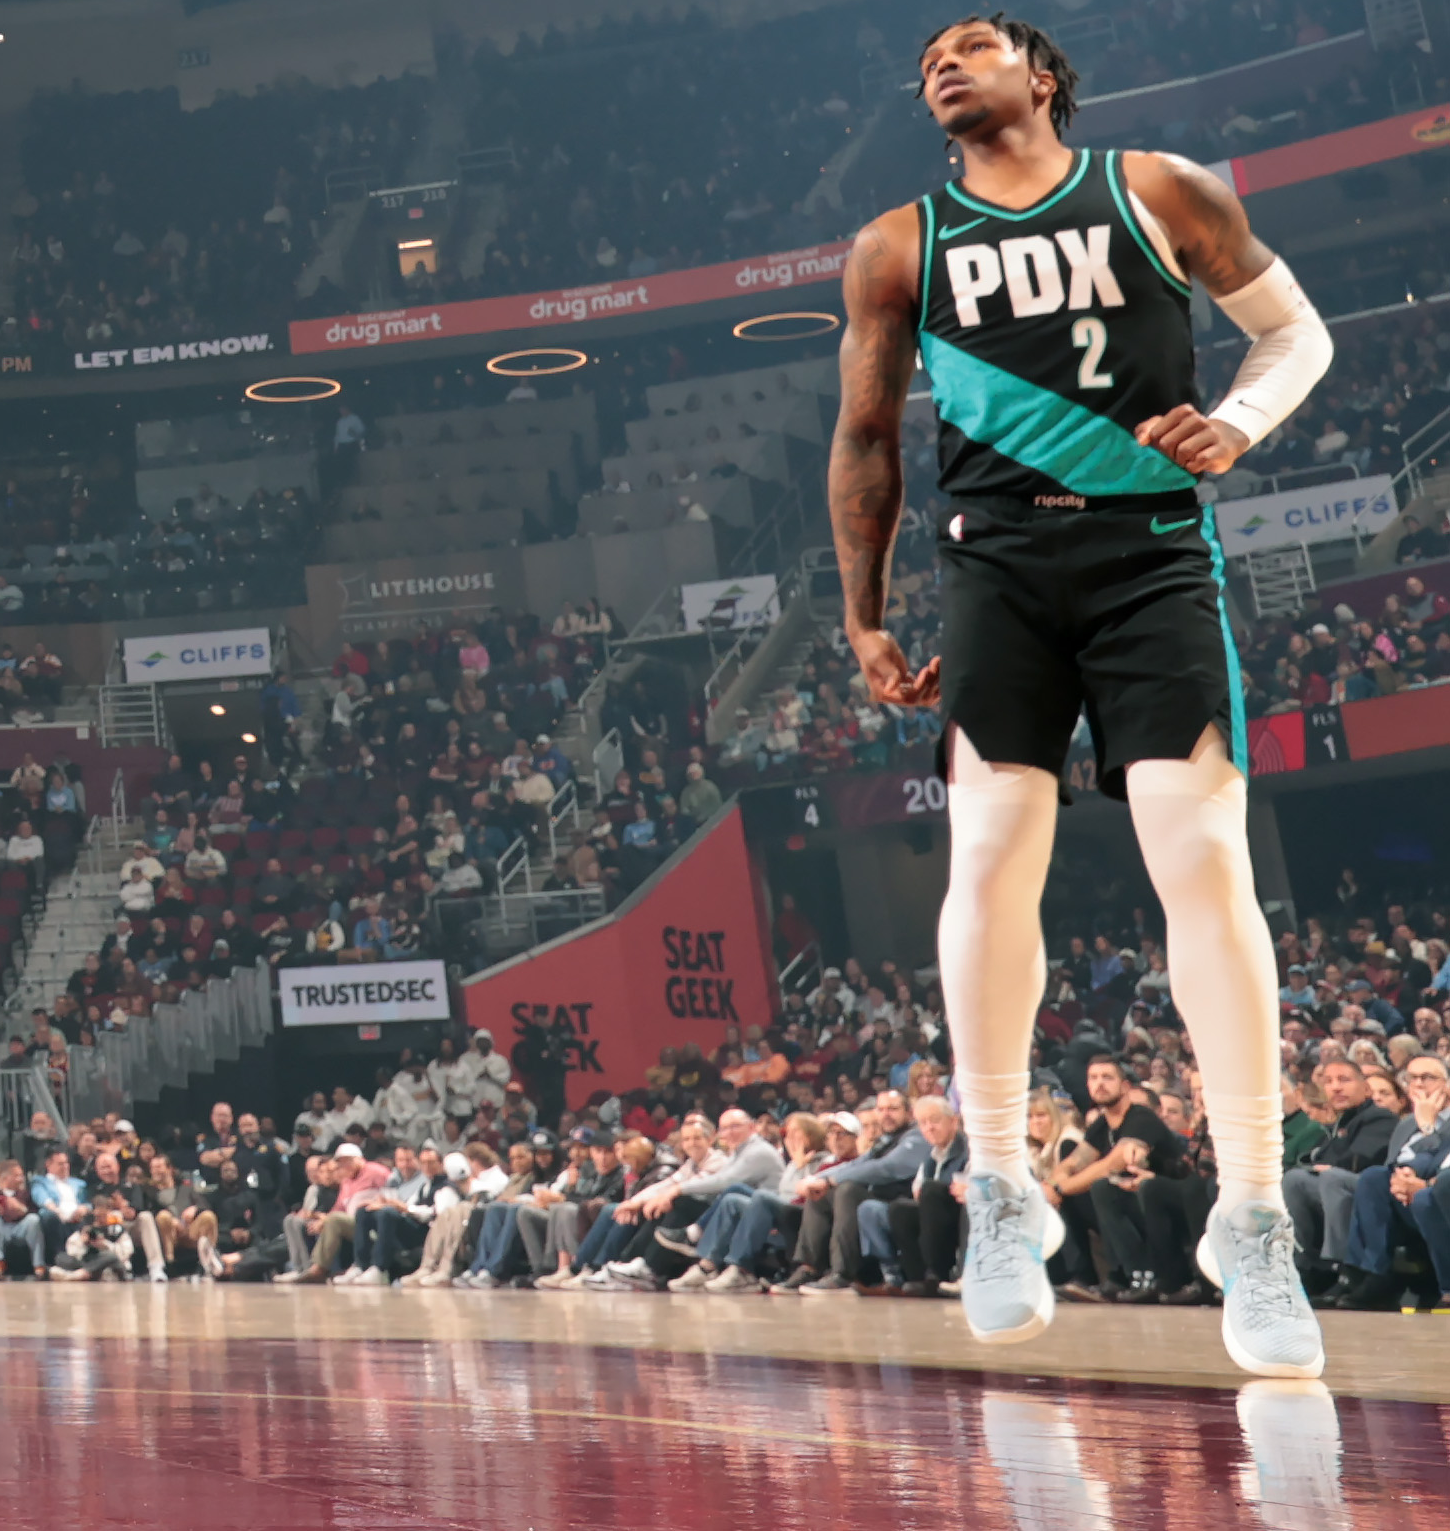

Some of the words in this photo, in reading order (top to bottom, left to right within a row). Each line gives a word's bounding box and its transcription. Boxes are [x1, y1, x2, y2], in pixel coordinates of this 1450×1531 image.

[735, 265, 794, 287] drug
[945, 223, 1126, 328] PDX
[530, 296, 587, 320] drug
[591, 285, 649, 312] mart
[325, 322, 381, 344] drug
[385, 312, 443, 336] mart
[2, 355, 33, 374] PM
[74, 350, 128, 370] LET
[130, 344, 176, 366] EM
[178, 333, 274, 361] KNOW.
[1071, 316, 1115, 390] 2
[1033, 494, 1087, 511] ripcity
[1284, 493, 1391, 529] CLIFFS
[370, 571, 496, 599] LITEHOUSE
[179, 642, 266, 665] CLIFFS
[1322, 733, 1337, 761] 1
[902, 775, 949, 815] 20
[804, 802, 820, 827] 4
[662, 925, 725, 972] SEAT
[291, 977, 436, 1008] TRUSTEDSEC
[665, 975, 740, 1023] GEEK
